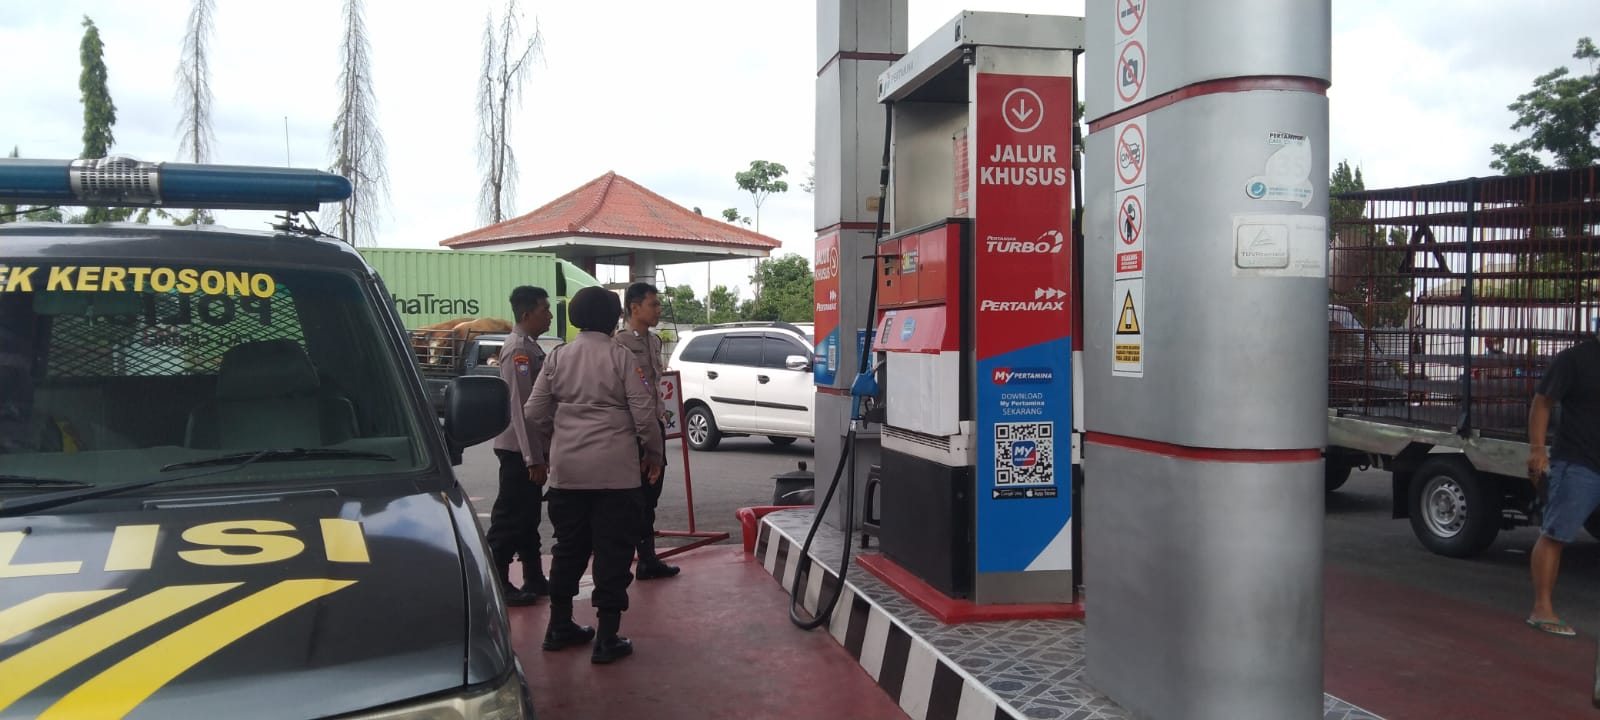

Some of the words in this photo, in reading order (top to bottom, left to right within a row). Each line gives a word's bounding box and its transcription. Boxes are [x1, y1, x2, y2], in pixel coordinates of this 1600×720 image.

[990, 144, 1056, 163] JALUR
[980, 166, 1066, 186] KHUSUS
[986, 241, 1050, 253] TURBO
[46, 266, 276, 298] KERTOSONO
[980, 299, 1065, 311] PERTAMAX
[995, 371, 1015, 384] My
[1001, 392, 1043, 400] DOWNLOAD
[1002, 408, 1042, 416] SEKARANG
[1014, 446, 1034, 458] My
